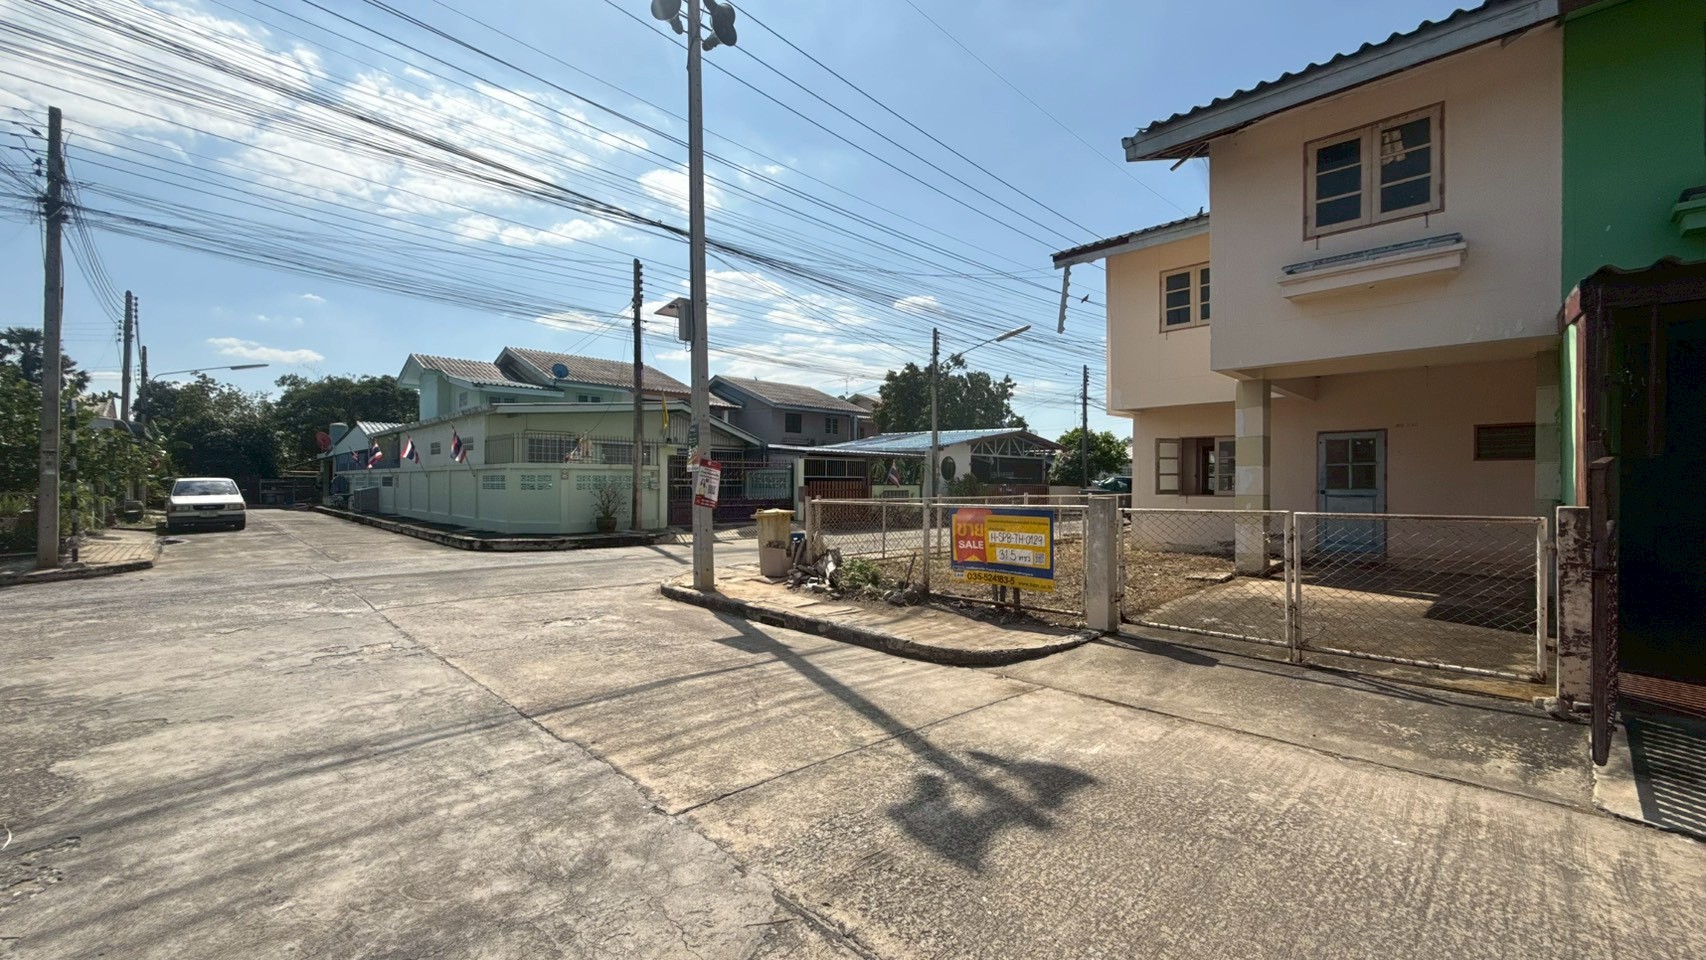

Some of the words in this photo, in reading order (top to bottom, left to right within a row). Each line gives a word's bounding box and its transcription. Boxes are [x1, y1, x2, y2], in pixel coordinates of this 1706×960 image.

[957, 523, 984, 537] ขาย
[958, 540, 984, 550] SALE
[966, 572, 1015, 585] 035-524183-5
